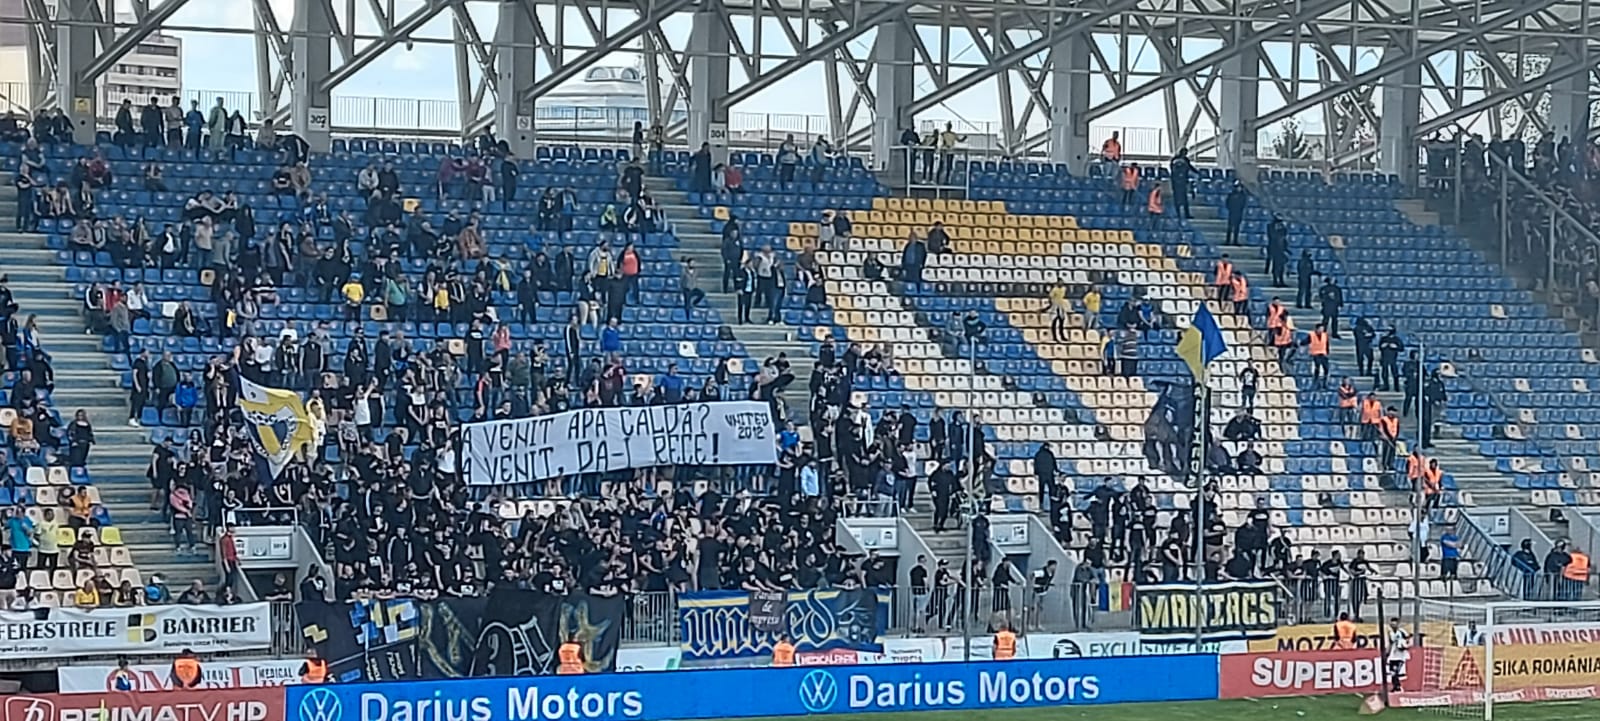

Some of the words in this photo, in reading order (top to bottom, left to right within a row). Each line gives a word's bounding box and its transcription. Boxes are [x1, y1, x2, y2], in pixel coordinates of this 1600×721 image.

[484, 418, 554, 452] VENIT
[568, 410, 607, 440] APA
[738, 427, 765, 440] 2012
[1140, 591, 1276, 628] MANIACS
[163, 616, 256, 634] BARRIER
[1493, 660, 1529, 676] SIKA
[361, 689, 491, 721] Darius
[508, 685, 642, 721] Motors
[850, 673, 966, 708] Darius
[979, 671, 1100, 703] Motors
[227, 701, 267, 721] HD
